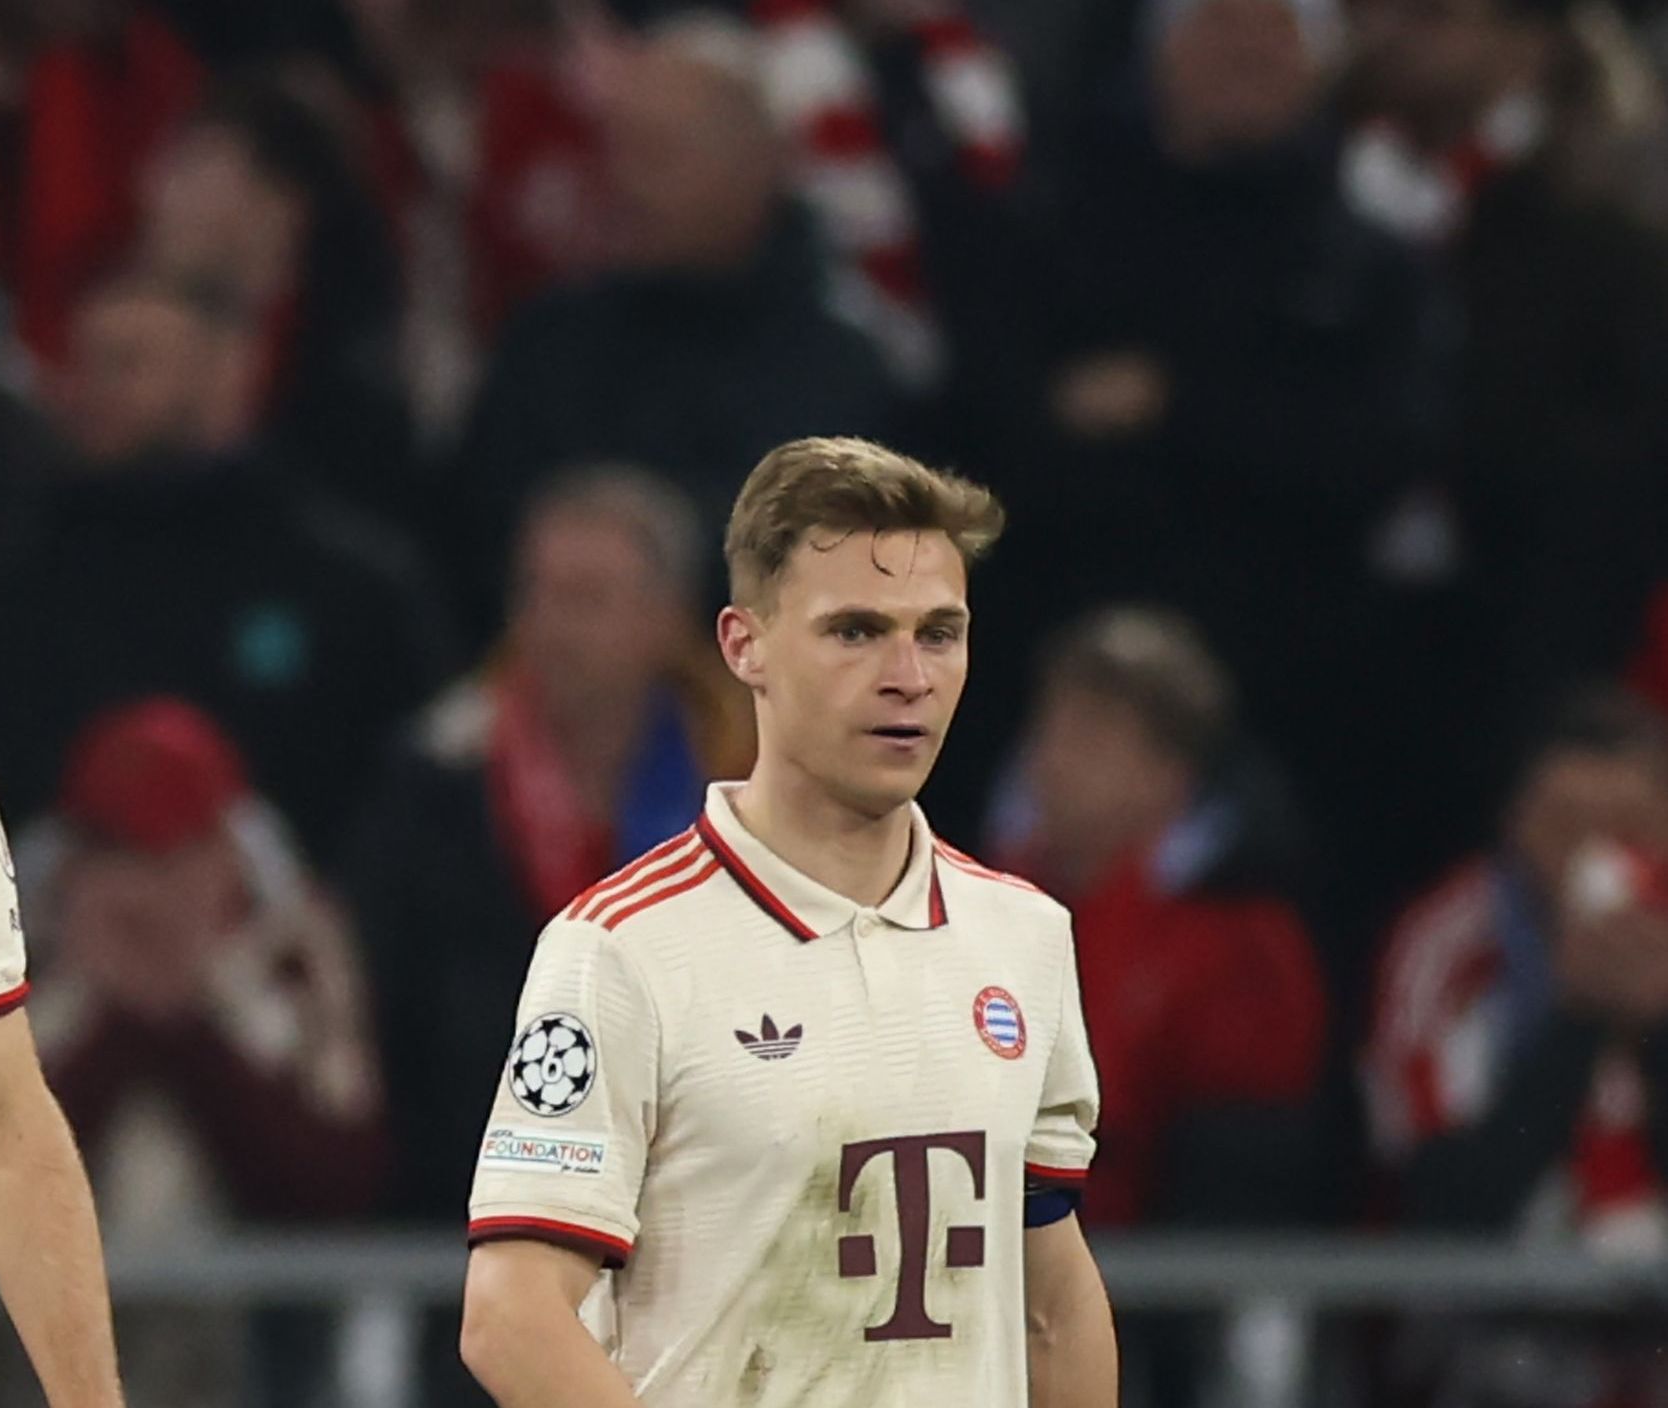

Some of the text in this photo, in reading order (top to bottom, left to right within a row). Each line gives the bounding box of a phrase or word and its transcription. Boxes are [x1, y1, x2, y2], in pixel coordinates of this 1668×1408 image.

[540, 1045, 565, 1084] 6
[483, 1139, 604, 1165] FOUNDATION
[838, 1130, 986, 1342] T
